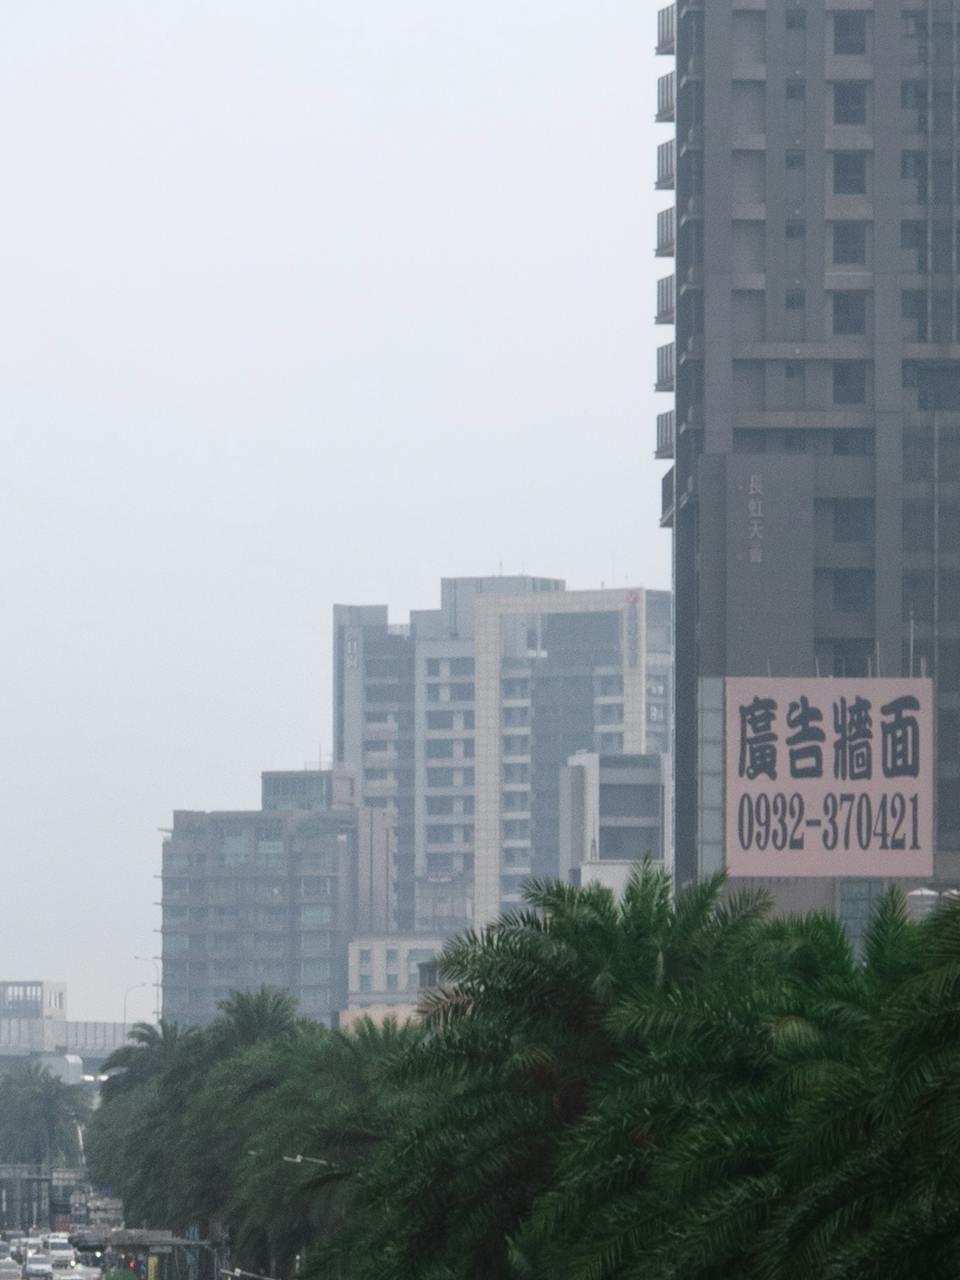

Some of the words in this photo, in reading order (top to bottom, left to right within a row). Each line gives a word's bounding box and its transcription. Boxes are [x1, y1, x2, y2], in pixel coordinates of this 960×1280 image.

[738, 695, 920, 781] 廣告牆面
[738, 792, 920, 850] 0932-370421
